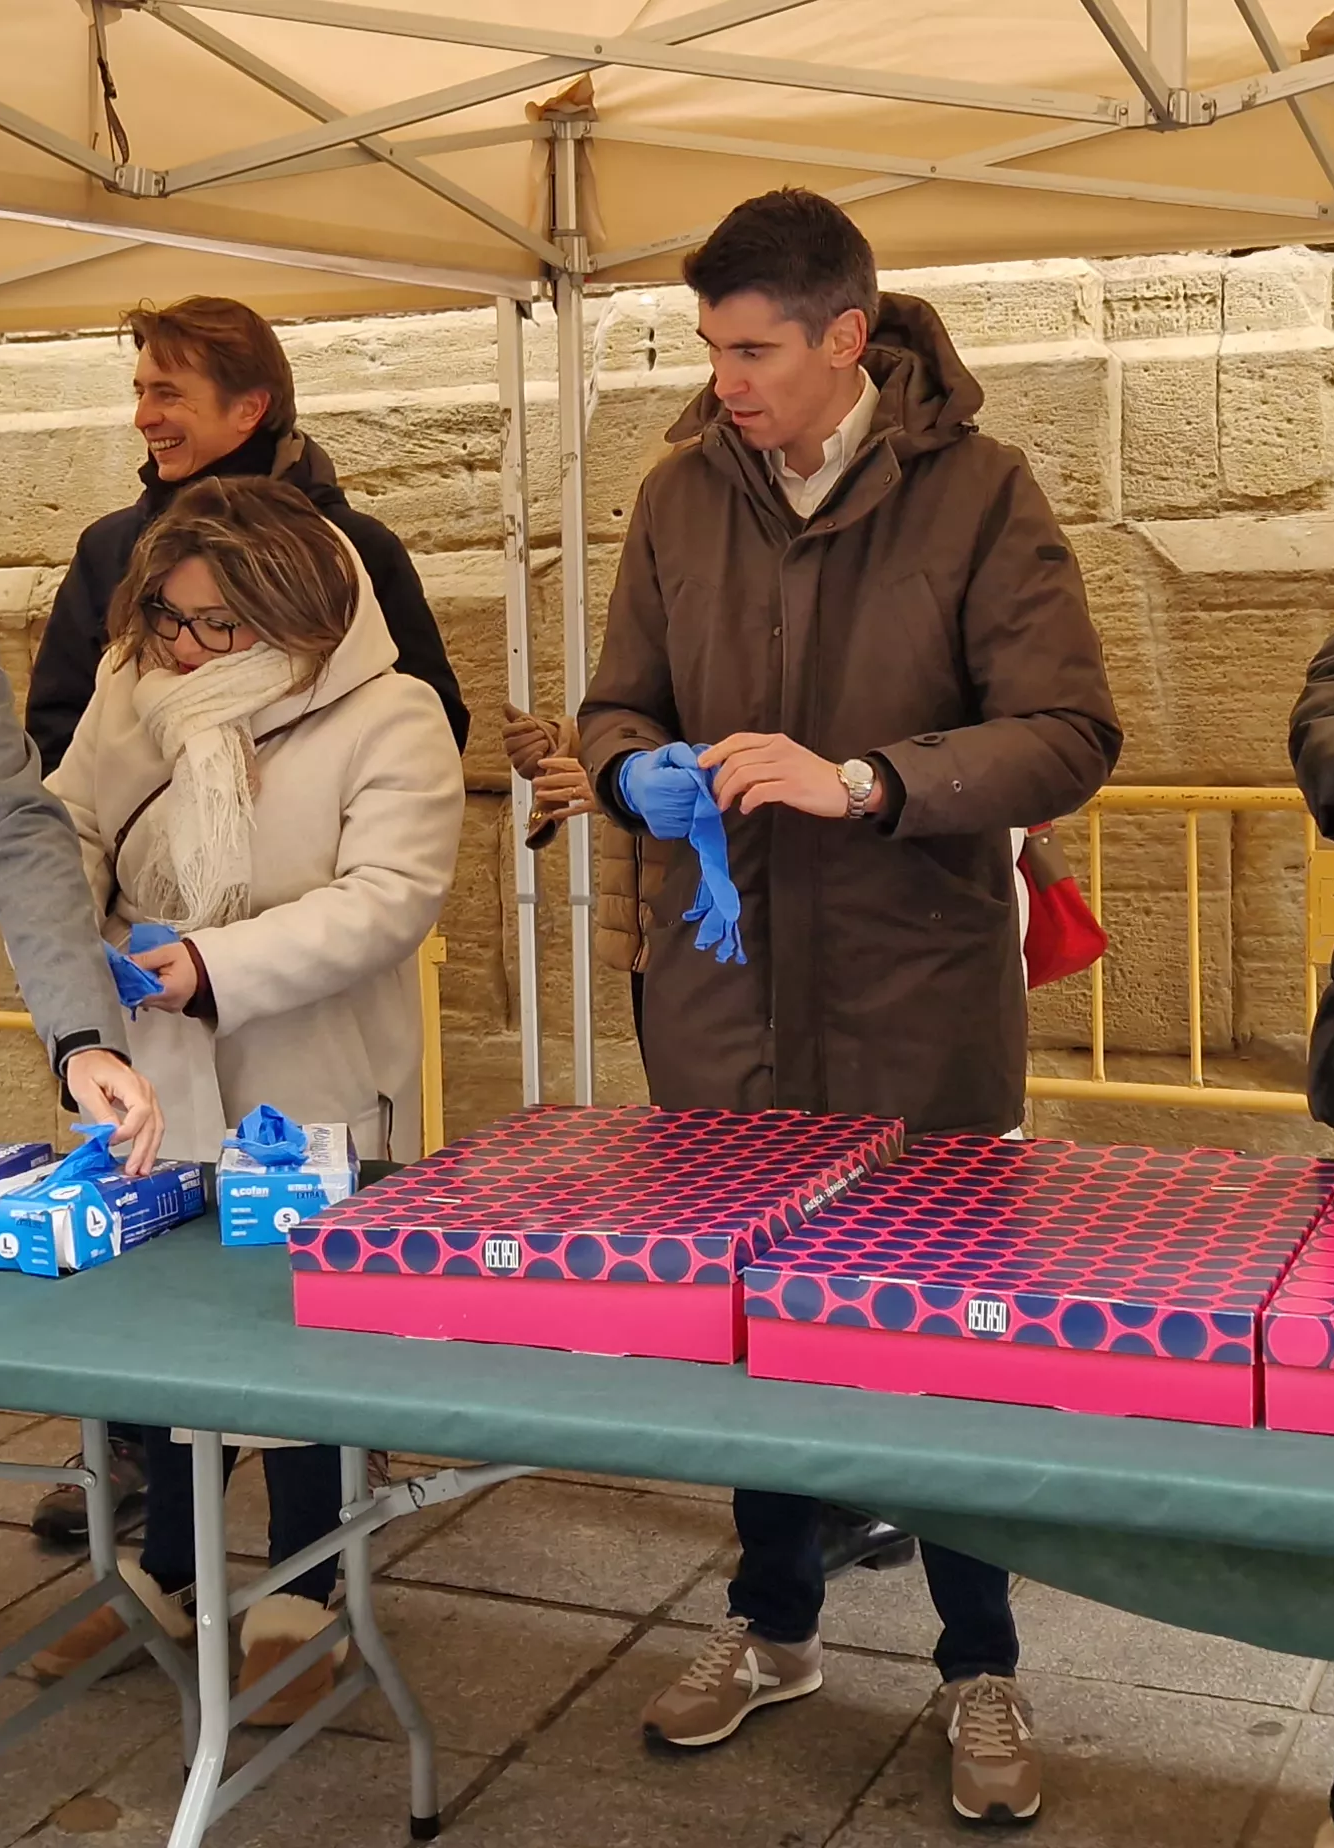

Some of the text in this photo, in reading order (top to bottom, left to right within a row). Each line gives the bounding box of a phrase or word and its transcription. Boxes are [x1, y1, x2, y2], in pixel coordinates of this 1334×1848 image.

[91, 1210, 101, 1226] L
[282, 1213, 292, 1223] S
[3, 1237, 12, 1250] L
